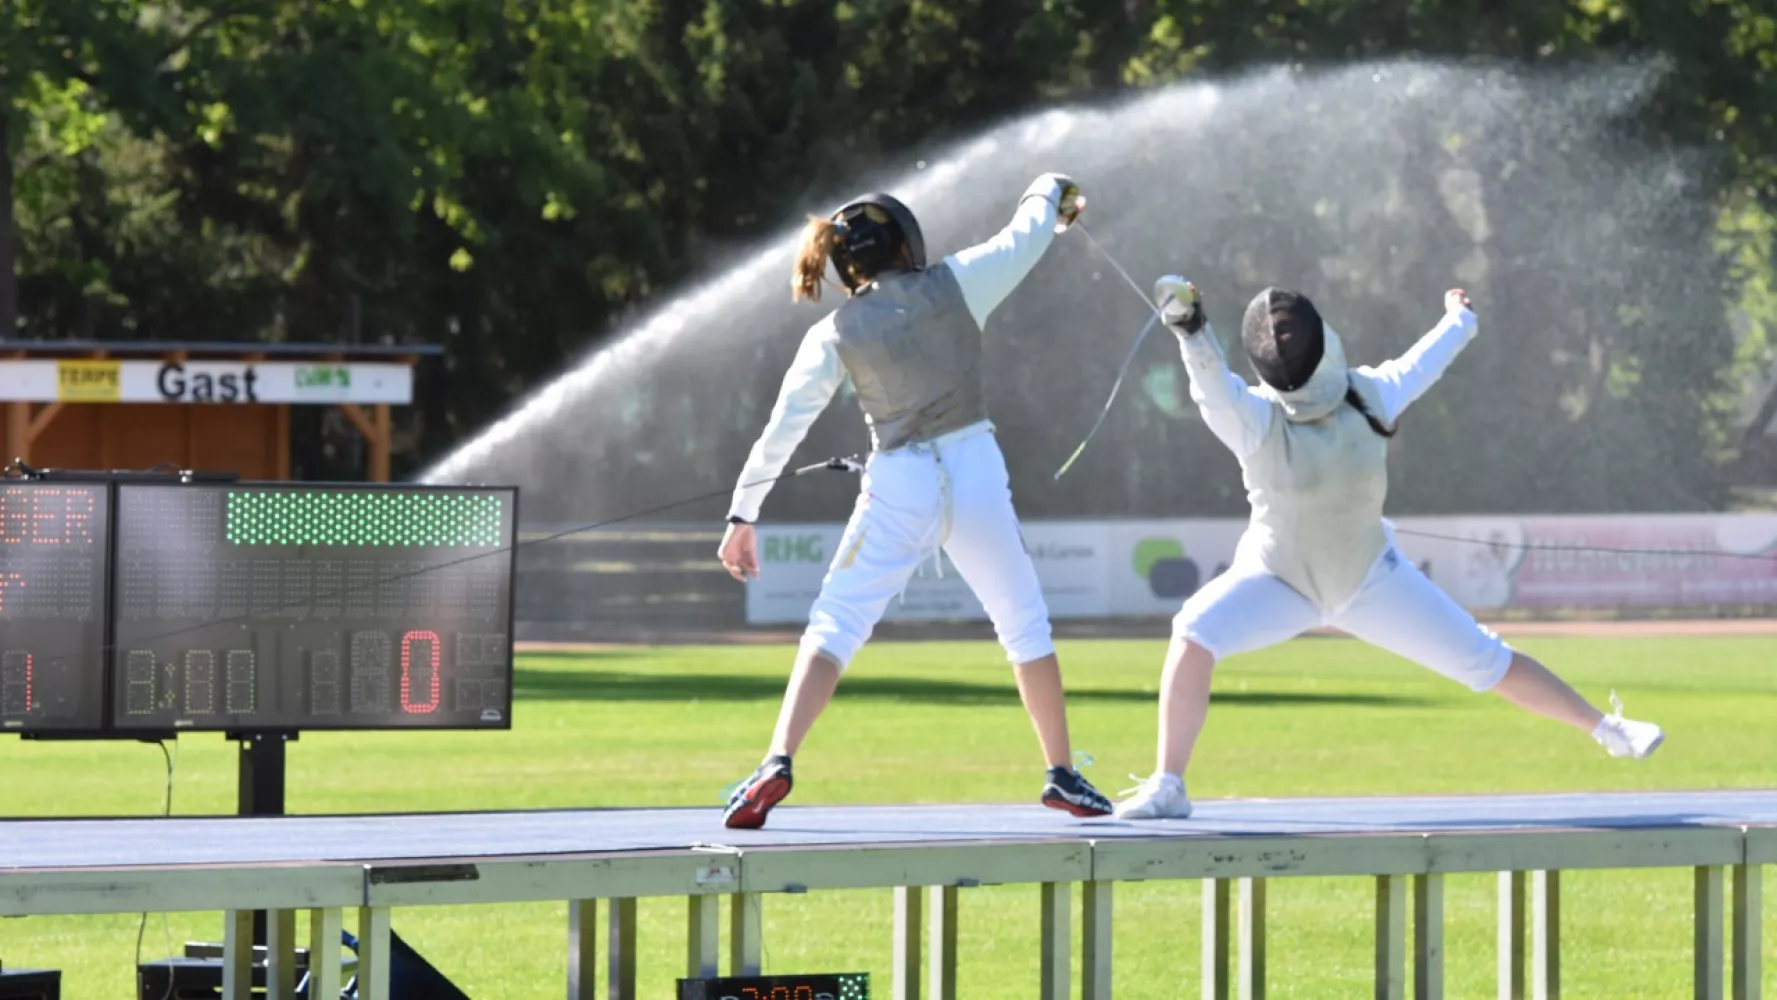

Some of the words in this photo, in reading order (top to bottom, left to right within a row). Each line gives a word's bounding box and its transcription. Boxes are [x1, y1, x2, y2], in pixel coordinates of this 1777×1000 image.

[156, 363, 259, 402] Gast
[763, 534, 824, 563] RHG
[400, 630, 440, 714] 0
